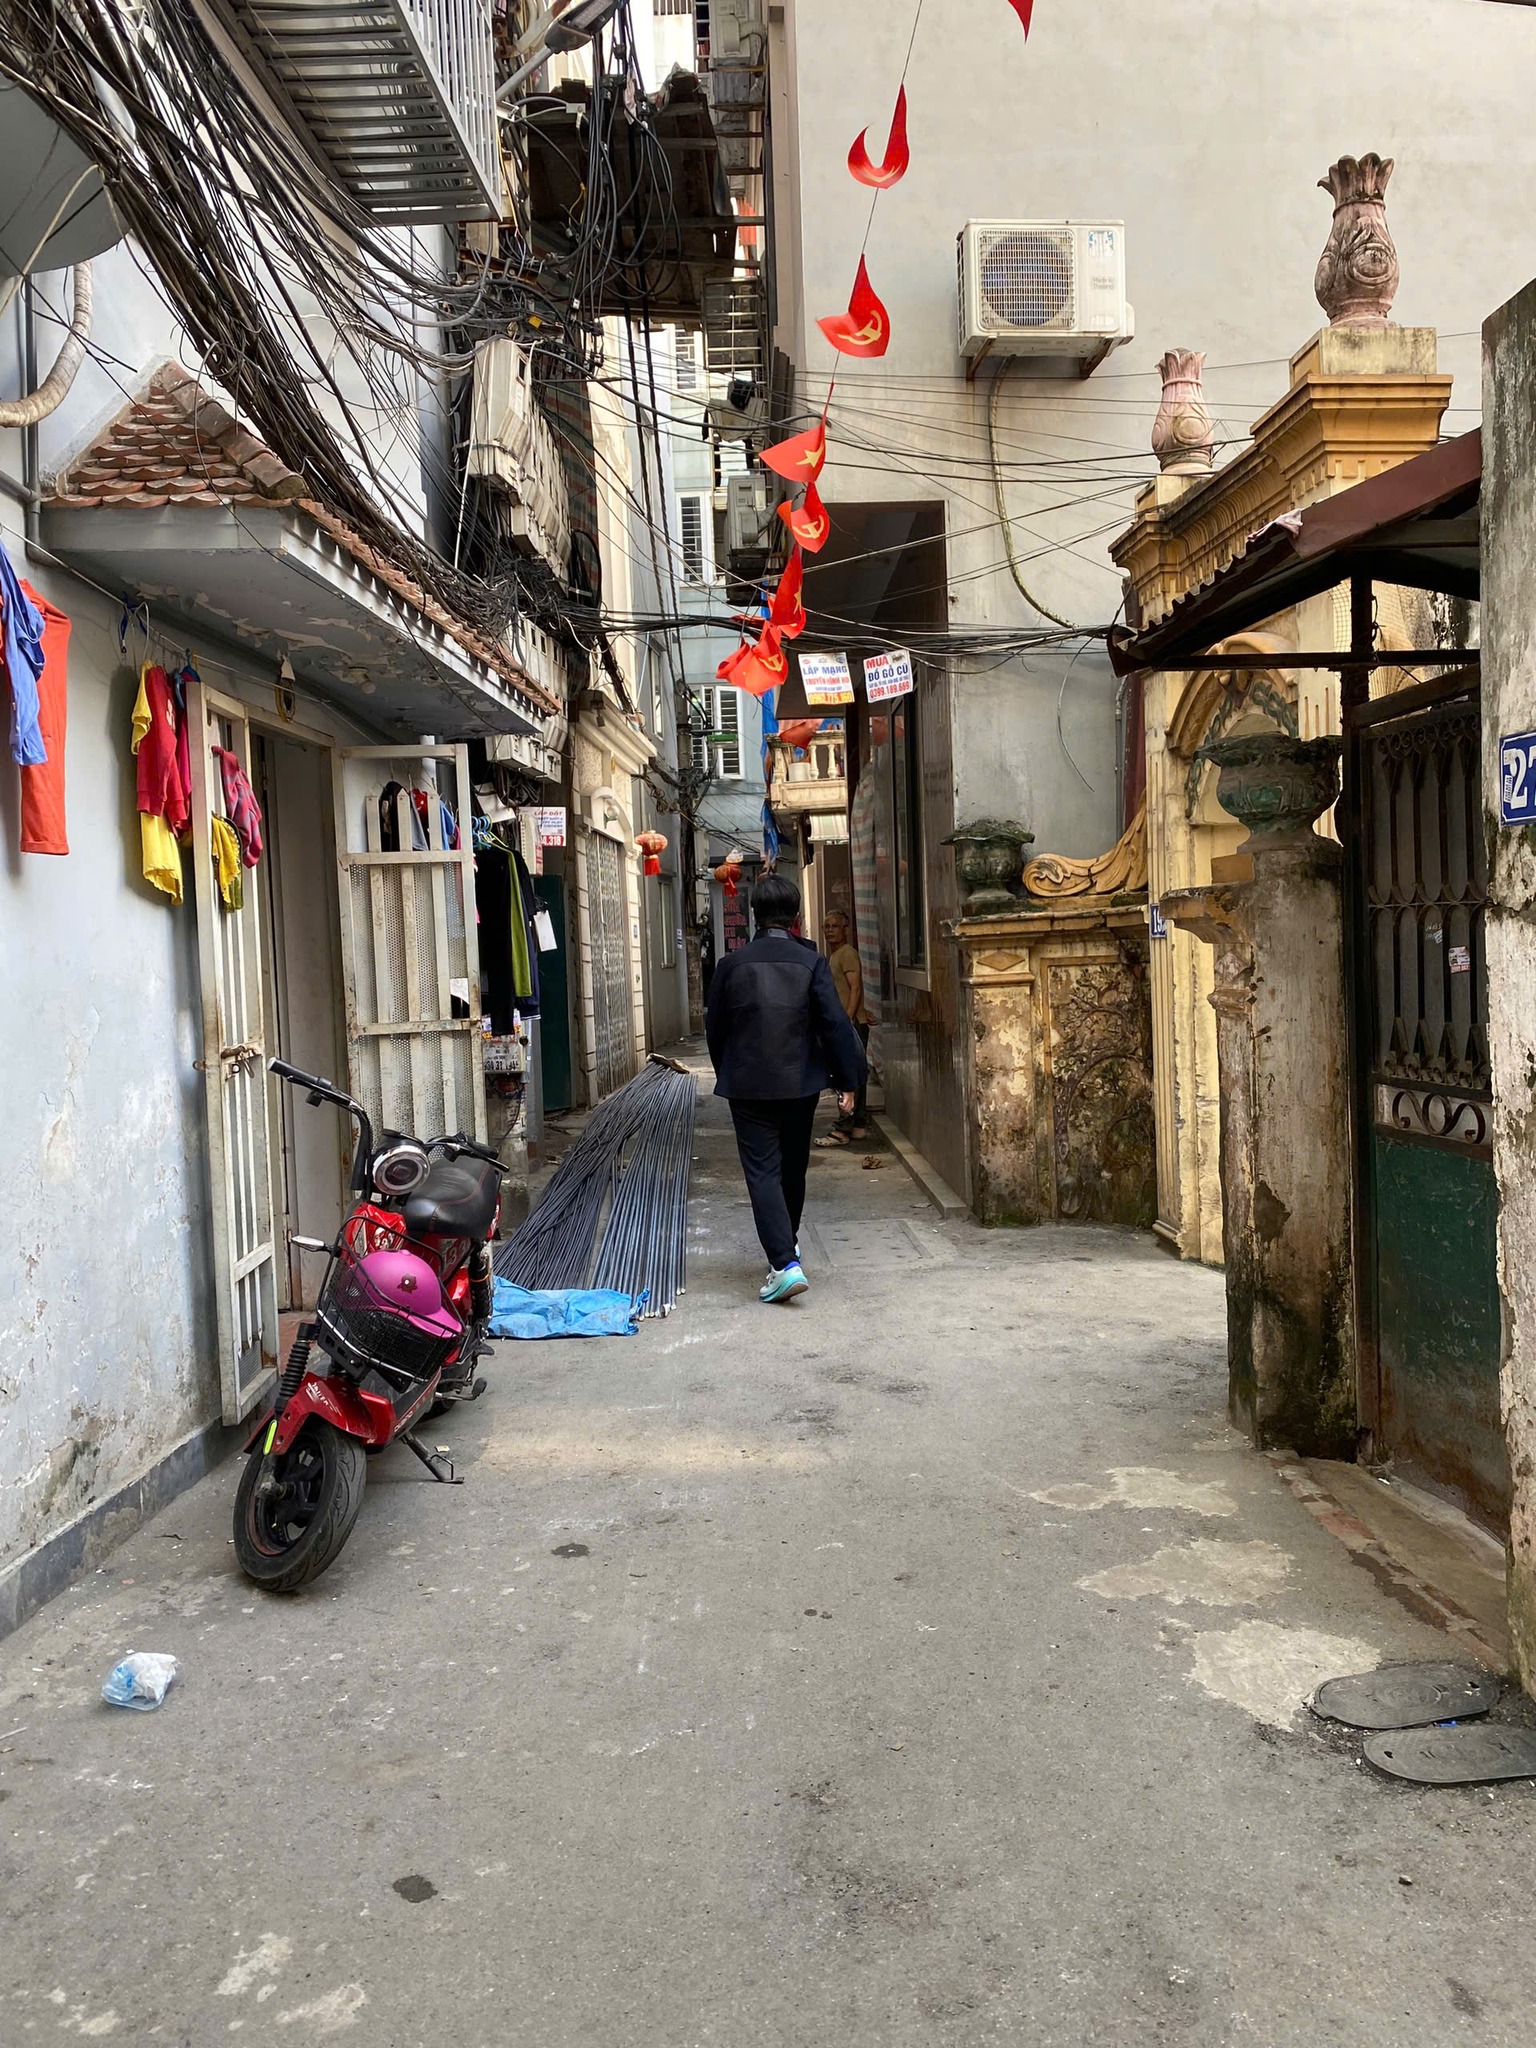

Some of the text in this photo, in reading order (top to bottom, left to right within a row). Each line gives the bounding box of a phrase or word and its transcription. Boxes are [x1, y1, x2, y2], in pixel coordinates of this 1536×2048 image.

[866, 656, 889, 669] MUA
[896, 662, 909, 676] CŨ
[822, 665, 848, 676] MẠNG
